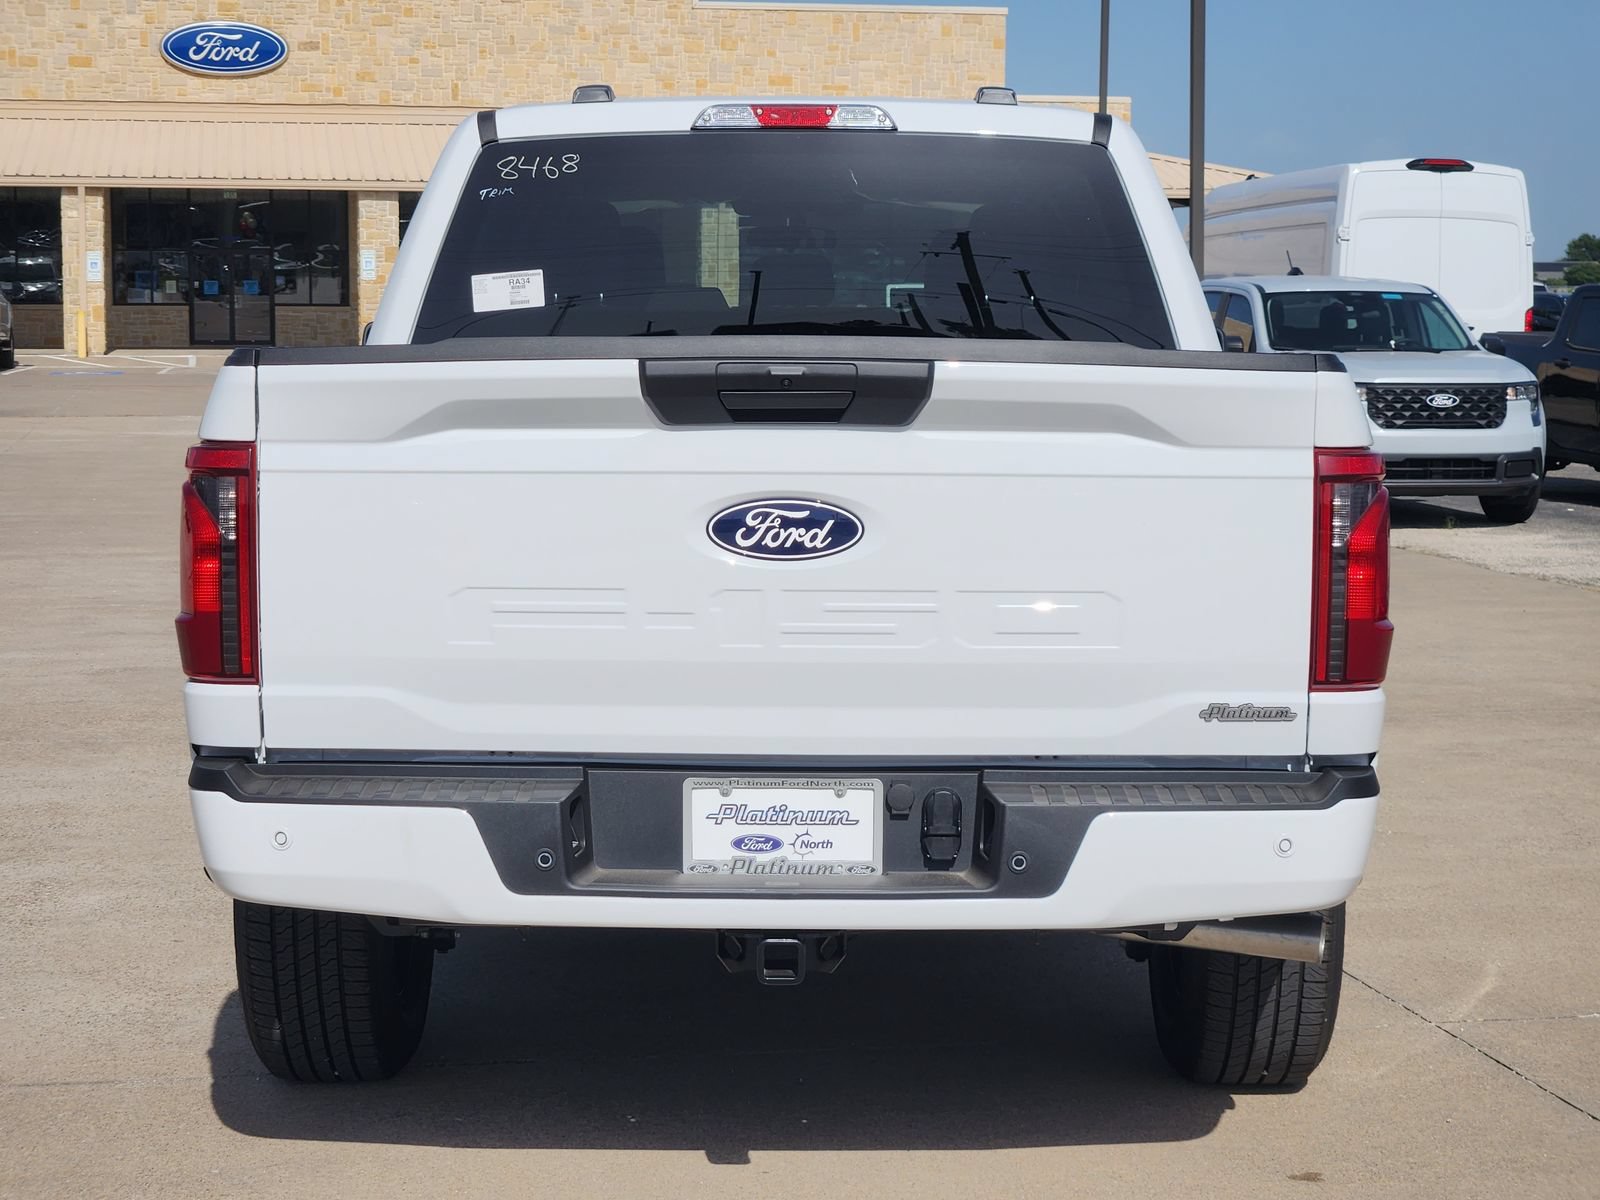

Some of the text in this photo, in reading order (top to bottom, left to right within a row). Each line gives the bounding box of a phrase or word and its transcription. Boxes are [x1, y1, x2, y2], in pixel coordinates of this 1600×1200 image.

[188, 31, 261, 62] Ford
[496, 153, 580, 180] 8468
[508, 277, 530, 286] RA34
[735, 507, 835, 549] Ford
[447, 586, 1123, 649] F-150
[1199, 703, 1298, 722] Platinum
[693, 779, 875, 788] www.PlatinumFordNorth.com
[705, 803, 860, 826] Platinum
[741, 837, 833, 851] Ford North
[693, 857, 874, 875] Ford Platinum Ford
